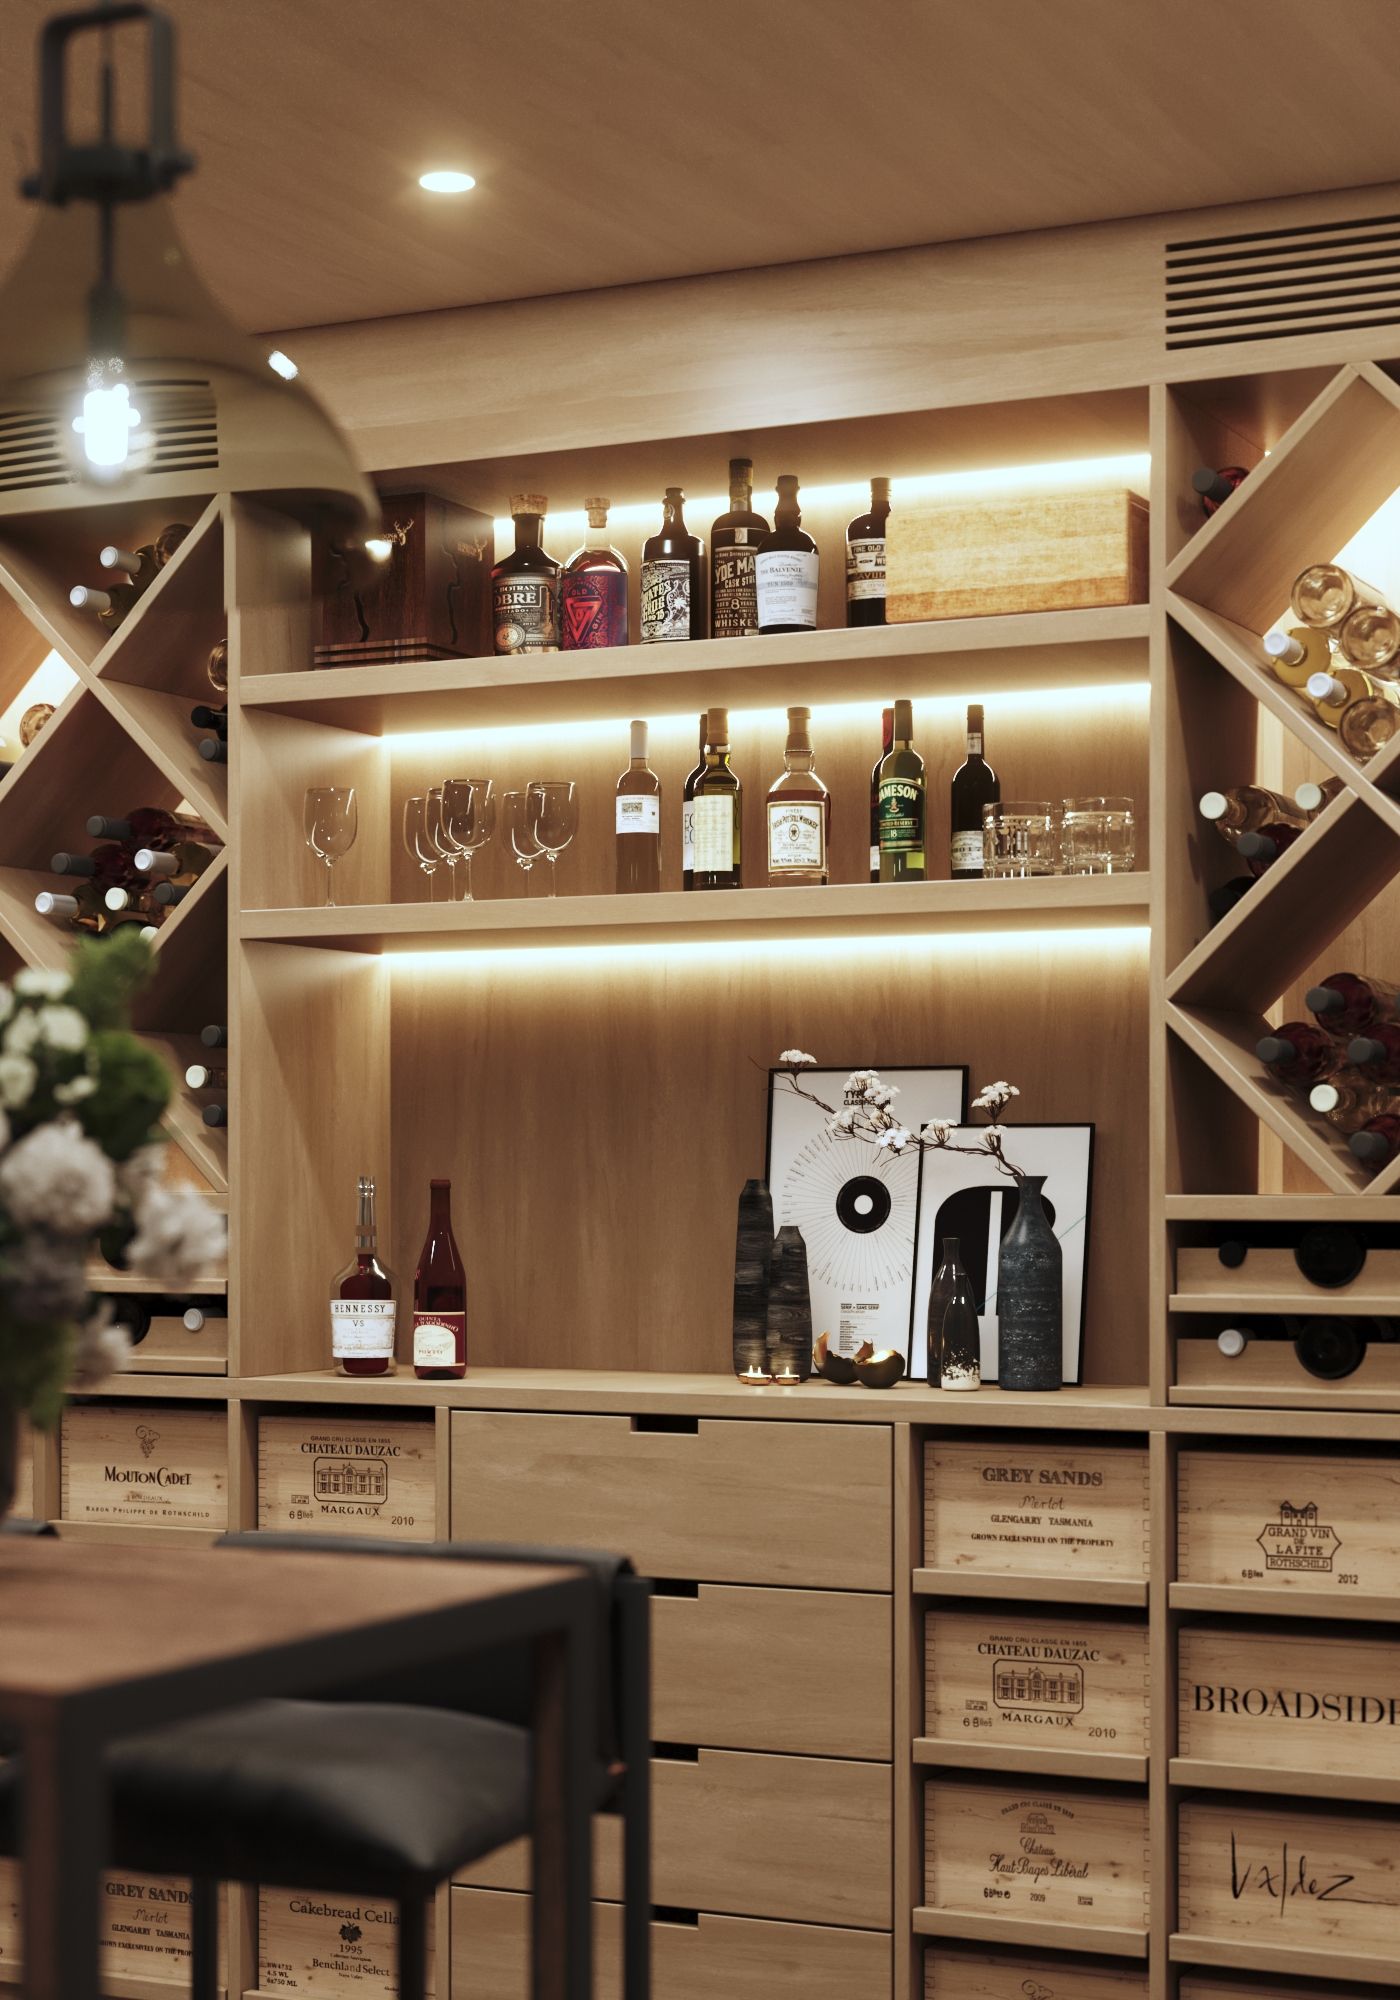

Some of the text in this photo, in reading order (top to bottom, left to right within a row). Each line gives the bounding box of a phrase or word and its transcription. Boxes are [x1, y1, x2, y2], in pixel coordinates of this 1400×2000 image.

[730, 598, 740, 610] 8
[334, 1304, 386, 1313] HENNESSY
[301, 1443, 400, 1456] CHATEAU DAUZAC
[982, 1467, 1103, 1486] GREY SANDS
[1019, 1495, 1065, 1510] Merlot
[321, 1505, 380, 1516] MARGAUX
[392, 1516, 414, 1526] 2010
[991, 1514, 1093, 1527] GLENGARRY TASMANIA
[1268, 1527, 1330, 1538] GRAND VIN
[971, 1533, 997, 1541] GROWN
[999, 1534, 1045, 1544] EXCLUSIVELY
[1060, 1537, 1075, 1545] THE
[1076, 1538, 1114, 1547] PROPERTY
[1276, 1545, 1323, 1556] LAFITE
[1270, 1558, 1328, 1569] ROTHSCHILD
[1338, 1574, 1358, 1584] 2012
[978, 1643, 1100, 1662] CHATEAU DAUZAC
[1002, 1712, 1074, 1727] MARGAUX
[1088, 1727, 1117, 1739] 2010
[106, 1882, 145, 1898] GREY
[1030, 1893, 1045, 1902] 2009
[133, 1908, 168, 1924] Merlot
[289, 1900, 360, 1920] Cakebread
[112, 1924, 190, 1940] GLENGARRY TASMANIA
[118, 1942, 154, 1952] EXCLUSIVELY
[339, 1944, 363, 1955] 1995
[312, 1958, 390, 1977] Benchland Select
